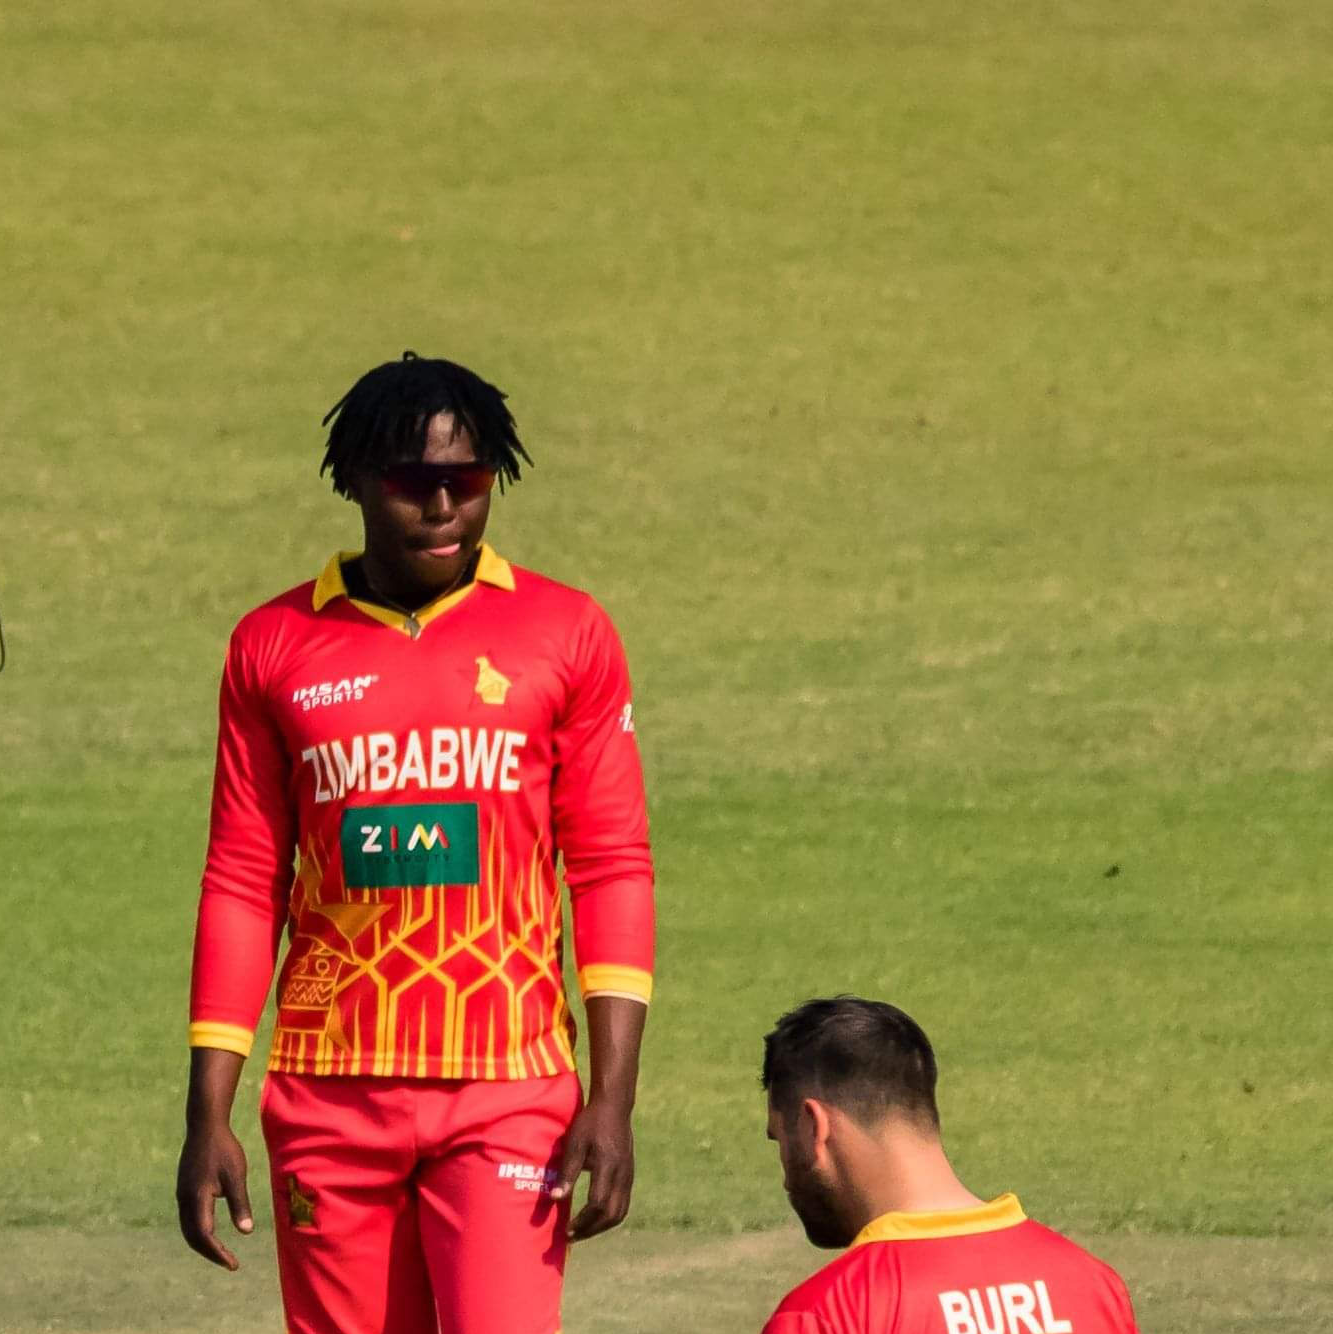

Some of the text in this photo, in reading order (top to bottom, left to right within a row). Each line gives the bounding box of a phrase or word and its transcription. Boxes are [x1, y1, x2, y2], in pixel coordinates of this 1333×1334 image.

[293, 675, 372, 703] IHSAN
[301, 688, 364, 711] SPORTS
[302, 727, 527, 804] ZIMBABWE
[360, 822, 450, 853] ZIM
